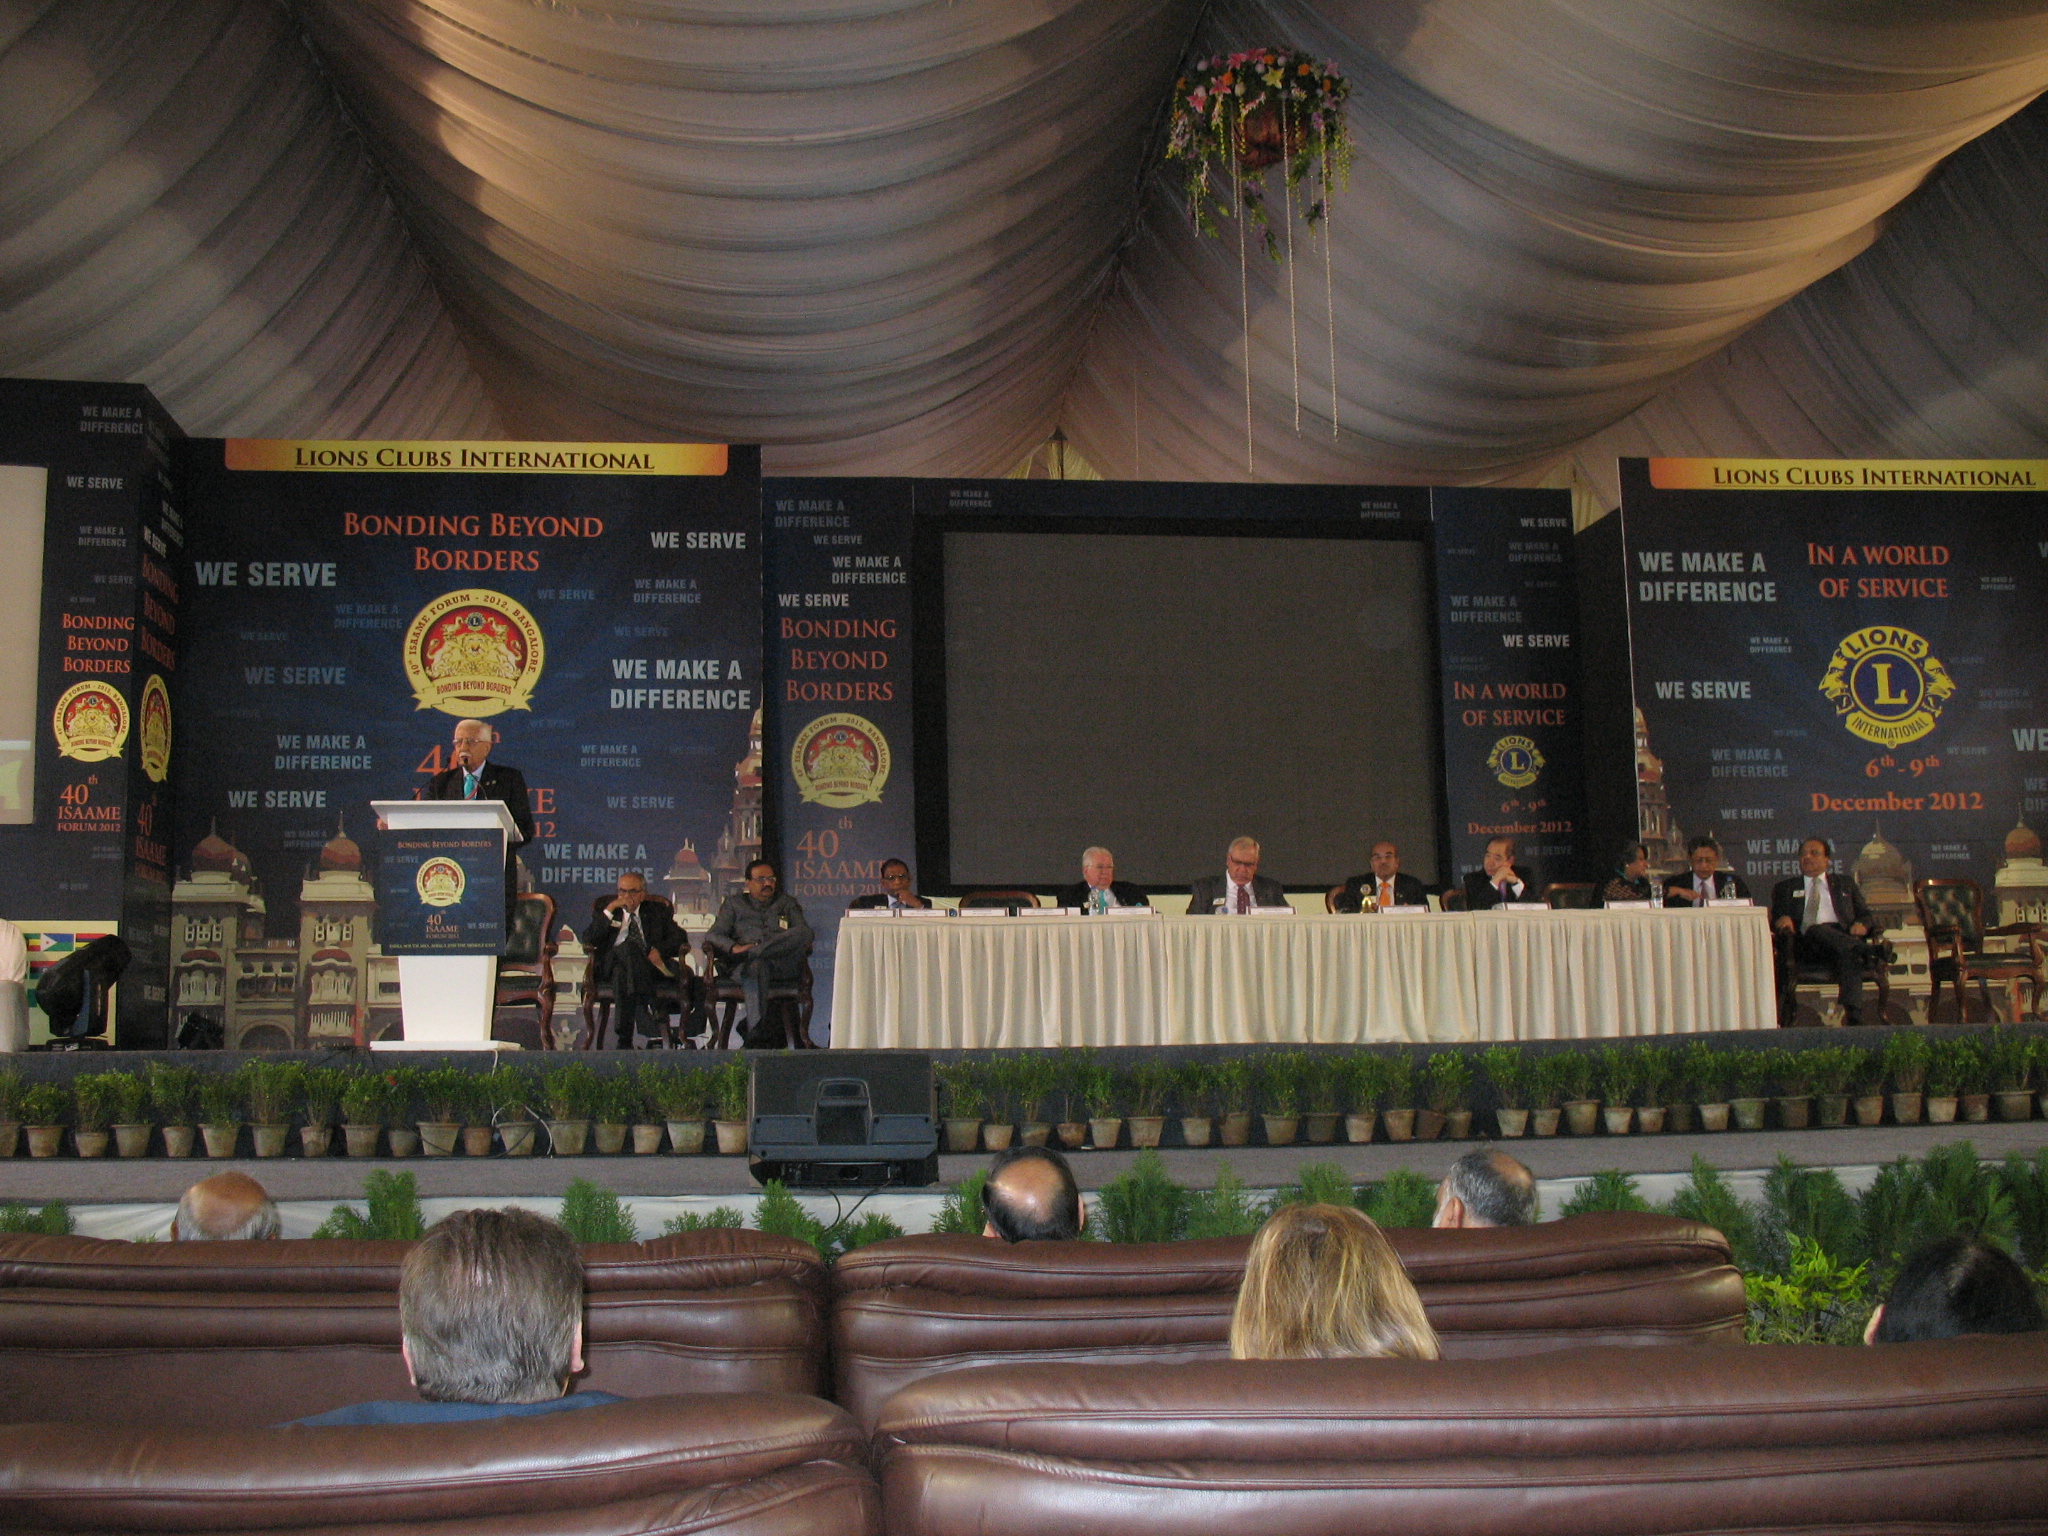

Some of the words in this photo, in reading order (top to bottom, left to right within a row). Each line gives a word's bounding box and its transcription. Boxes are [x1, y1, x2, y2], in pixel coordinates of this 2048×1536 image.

[82, 405, 98, 417] WE
[102, 406, 132, 418] MAKE
[135, 407, 142, 419] A
[296, 448, 368, 467] LIONS
[376, 448, 451, 467] CLUBS
[461, 449, 655, 469] INTERNATIONAL
[67, 476, 84, 488] WE
[87, 477, 123, 490] SERVE
[1713, 467, 1779, 485] LIONS
[1786, 467, 1854, 485] CLUBS
[1862, 468, 2036, 486] INTERNATIONAL
[775, 500, 796, 511] WE
[799, 500, 833, 511] MAKE
[837, 500, 845, 511] A
[344, 512, 481, 537] BONDING
[490, 513, 605, 538] BEYOND
[775, 516, 850, 528] DIFFERENCE
[1521, 518, 1535, 527] WE
[1537, 518, 1567, 527] SERVE
[80, 525, 92, 535] WE
[94, 526, 115, 536] MAKE
[78, 537, 127, 547] DIFFERENCE
[651, 531, 679, 549] WE
[686, 531, 746, 549] SERVE
[813, 535, 829, 545] WE
[832, 535, 863, 545] SERVE
[414, 546, 541, 572] BORDERS
[1807, 542, 1835, 565] IN
[1841, 546, 1858, 565] A
[1863, 545, 1950, 566] WORLD
[832, 556, 851, 568] WE
[855, 556, 889, 568] MAKE
[893, 556, 901, 568] A
[1639, 552, 1674, 573] WE
[1682, 552, 1744, 573] MAKE
[1751, 552, 1766, 573] A
[195, 561, 237, 586] WE
[248, 561, 337, 586] SERVE
[832, 572, 907, 584] DIFFERENCE
[635, 579, 651, 589] WE
[655, 579, 685, 589] MAKE
[688, 579, 697, 589] A
[1639, 581, 1777, 601] DIFFERENCE
[1819, 578, 1849, 598] OF
[1858, 578, 1950, 598] SERVICE
[633, 592, 701, 604] DIFFERENCE
[778, 594, 800, 607] WE
[805, 594, 849, 607] SERVE
[1451, 596, 1468, 607] WE
[1473, 596, 1505, 607] MAKE
[1510, 596, 1517, 607] A
[62, 613, 135, 630] BONDING
[1451, 611, 1522, 623] DIFFERENCE
[409, 615, 430, 655] ISAAME
[430, 594, 470, 616] FORUM
[513, 609, 539, 673] BANGALORE
[780, 617, 897, 638] BONDING
[67, 635, 129, 652] BEYOND
[1503, 634, 1523, 647] WE
[1528, 634, 1570, 647] SERVE
[1845, 629, 1923, 655] LIONS
[63, 656, 131, 673] BORDERS
[791, 649, 889, 670] BEYOND
[244, 666, 275, 685] WE
[283, 666, 346, 685] SERVE
[612, 659, 647, 679] WE
[656, 660, 720, 680] MAKE
[727, 660, 742, 680] A
[463, 681, 484, 690] BEYOND
[486, 682, 512, 695] BORDERS
[786, 680, 894, 701] BORDERS
[1454, 681, 1475, 699] IN
[1481, 684, 1494, 699] A
[1498, 683, 1567, 699] WORLD
[1655, 681, 1685, 699] WE
[1691, 681, 1751, 699] SERVE
[1872, 663, 1908, 704] L
[610, 688, 750, 710] DIFFERENCE
[1462, 710, 1488, 726] OF
[1493, 709, 1566, 726] SERVICE
[1851, 716, 1929, 739] INTERNATIONAL
[277, 735, 300, 750] WE
[306, 735, 351, 750] MAKE
[356, 735, 366, 750] A
[1499, 737, 1533, 749] LIONS
[2012, 728, 2048, 752] WE
[582, 745, 598, 755] WE
[600, 745, 626, 755] MAKE
[628, 745, 637, 755] A
[1712, 749, 1731, 761] WE
[1735, 749, 1771, 761] MAKE
[1774, 749, 1782, 761] A
[275, 755, 372, 770] DIFFERENCE
[580, 757, 641, 768] DIFFERENCE
[1510, 752, 1525, 770] L
[1712, 765, 1788, 777] DIFFERENCE
[228, 790, 258, 808] WE
[264, 790, 327, 808] SERVE
[606, 796, 626, 809] WE
[632, 796, 675, 809] SERVE
[1811, 791, 1925, 812] December
[1929, 792, 1984, 810] 2012
[58, 805, 121, 820] ISAAME
[1721, 809, 1737, 820] WE
[1740, 809, 1774, 820] SERVE
[57, 823, 97, 832] FORUM
[99, 823, 121, 832] 2012
[1468, 821, 1537, 834] December
[1540, 821, 1573, 834] 2012
[543, 843, 572, 860] WE
[578, 843, 629, 860] MAKE
[635, 843, 647, 860] A
[1747, 839, 1771, 854] WE
[1776, 839, 1802, 854] MA
[793, 884, 856, 896] FORUM
[426, 925, 459, 933] ISAAME
